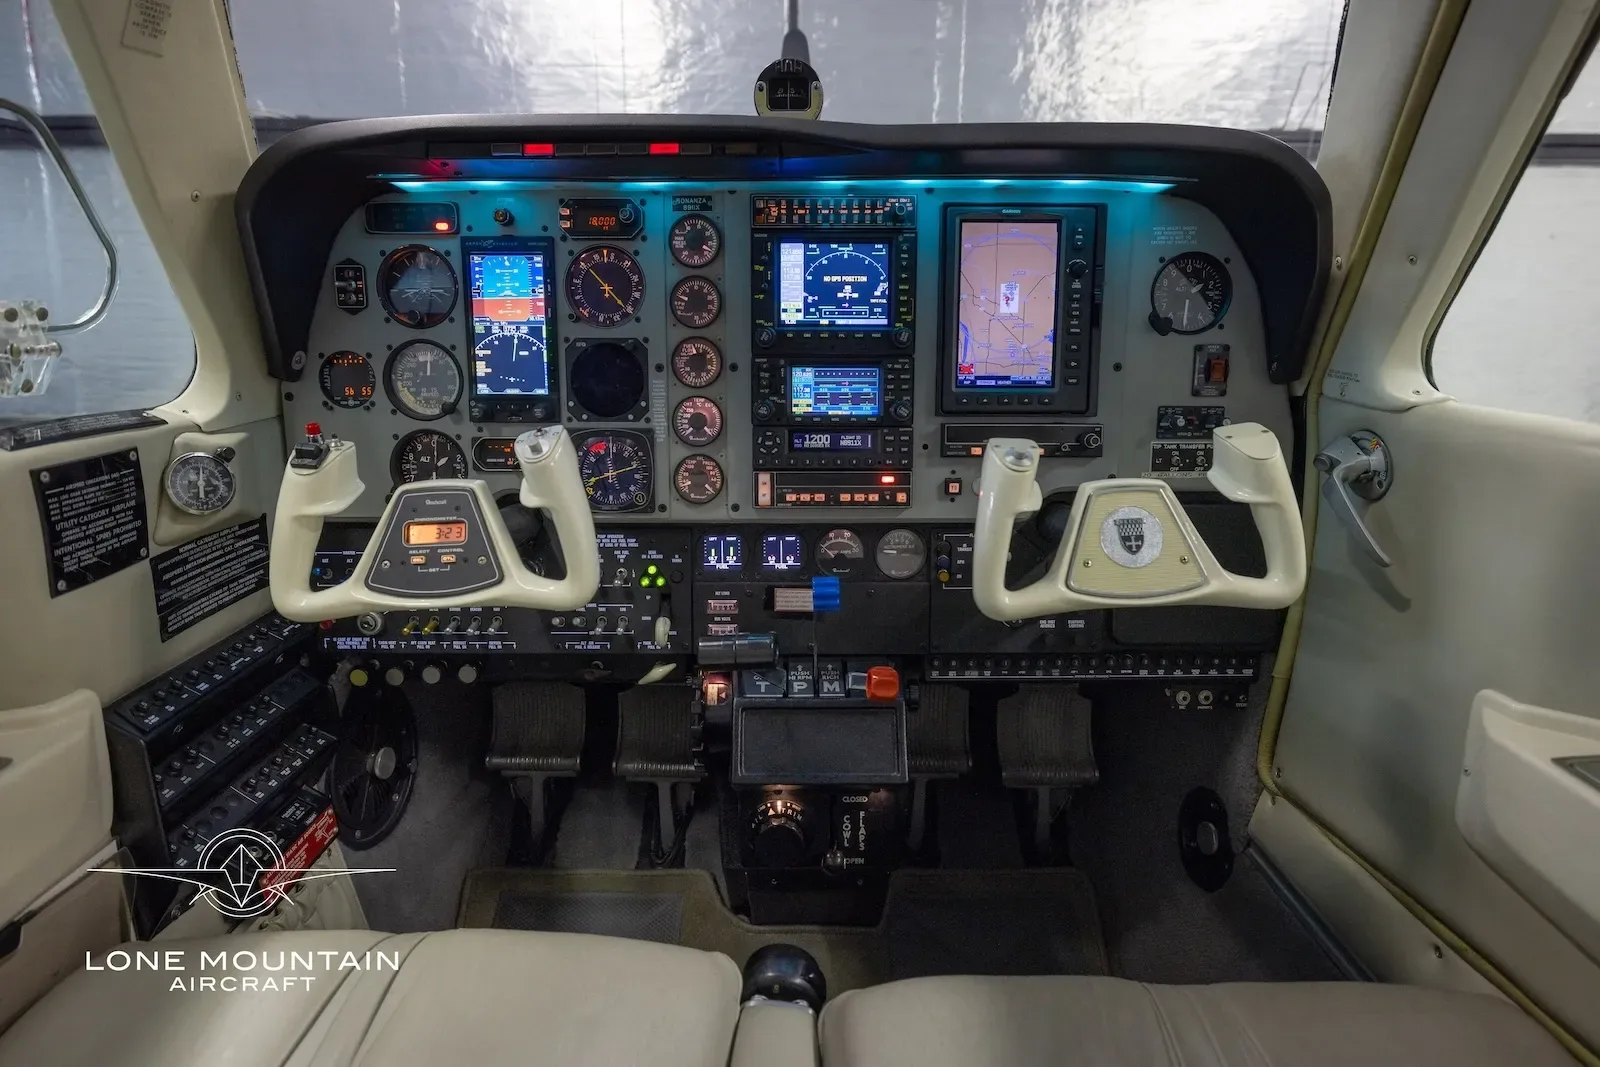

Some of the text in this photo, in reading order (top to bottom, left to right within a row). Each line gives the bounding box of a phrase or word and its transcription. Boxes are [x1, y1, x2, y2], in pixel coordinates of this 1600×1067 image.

[676, 197, 707, 205] BONANZA
[1209, 280, 1214, 289] 2
[804, 434, 831, 444] 1200
[417, 443, 422, 451] 9
[409, 453, 414, 461] 8
[54, 499, 136, 531] UTILITY CATEGORY AIRPLANE
[53, 519, 141, 557] INTENTIONAL SPINS PROHIBITED
[755, 682, 840, 692] T P M
[781, 808, 804, 821] TRIM
[843, 815, 852, 847] COWL
